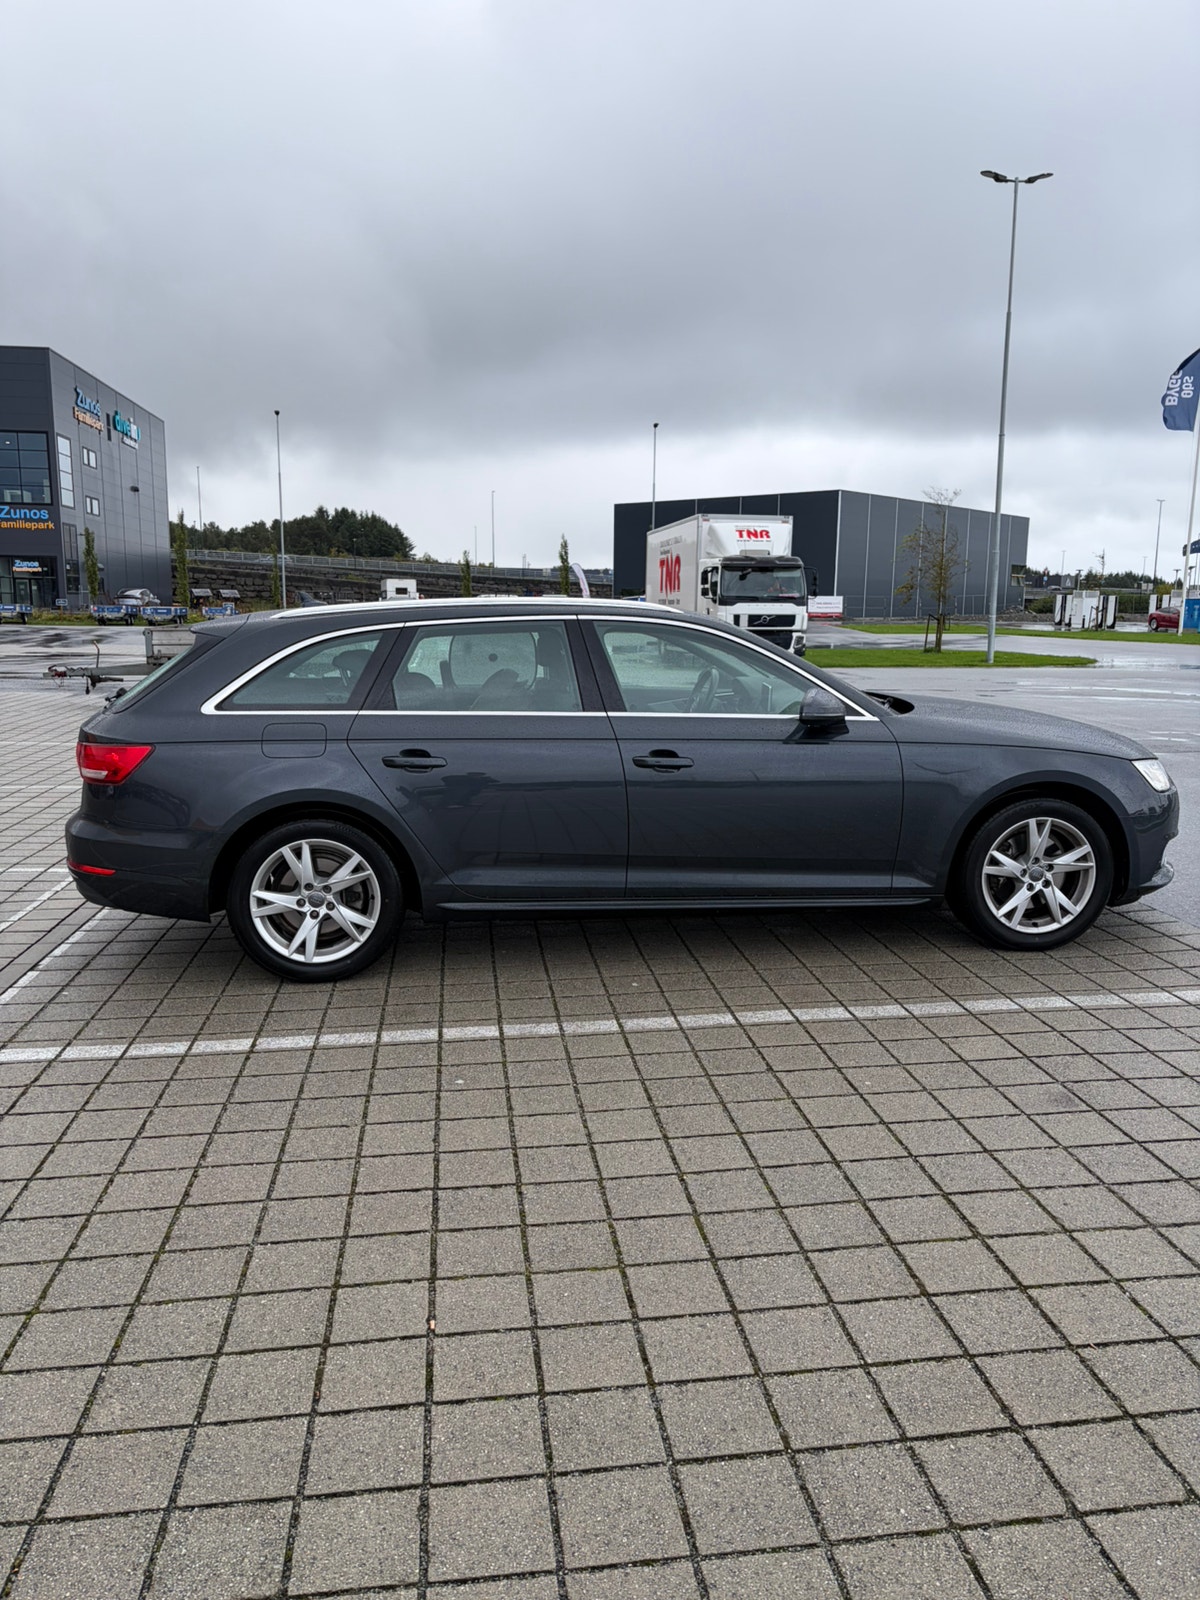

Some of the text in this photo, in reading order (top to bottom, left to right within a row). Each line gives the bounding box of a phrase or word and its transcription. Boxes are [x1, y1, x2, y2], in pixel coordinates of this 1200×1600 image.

[75, 387, 101, 417] Zunos
[0, 505, 49, 519] Zunos
[0, 520, 55, 531] amiliepark
[736, 528, 771, 540] TNR
[659, 548, 681, 598] TNR
